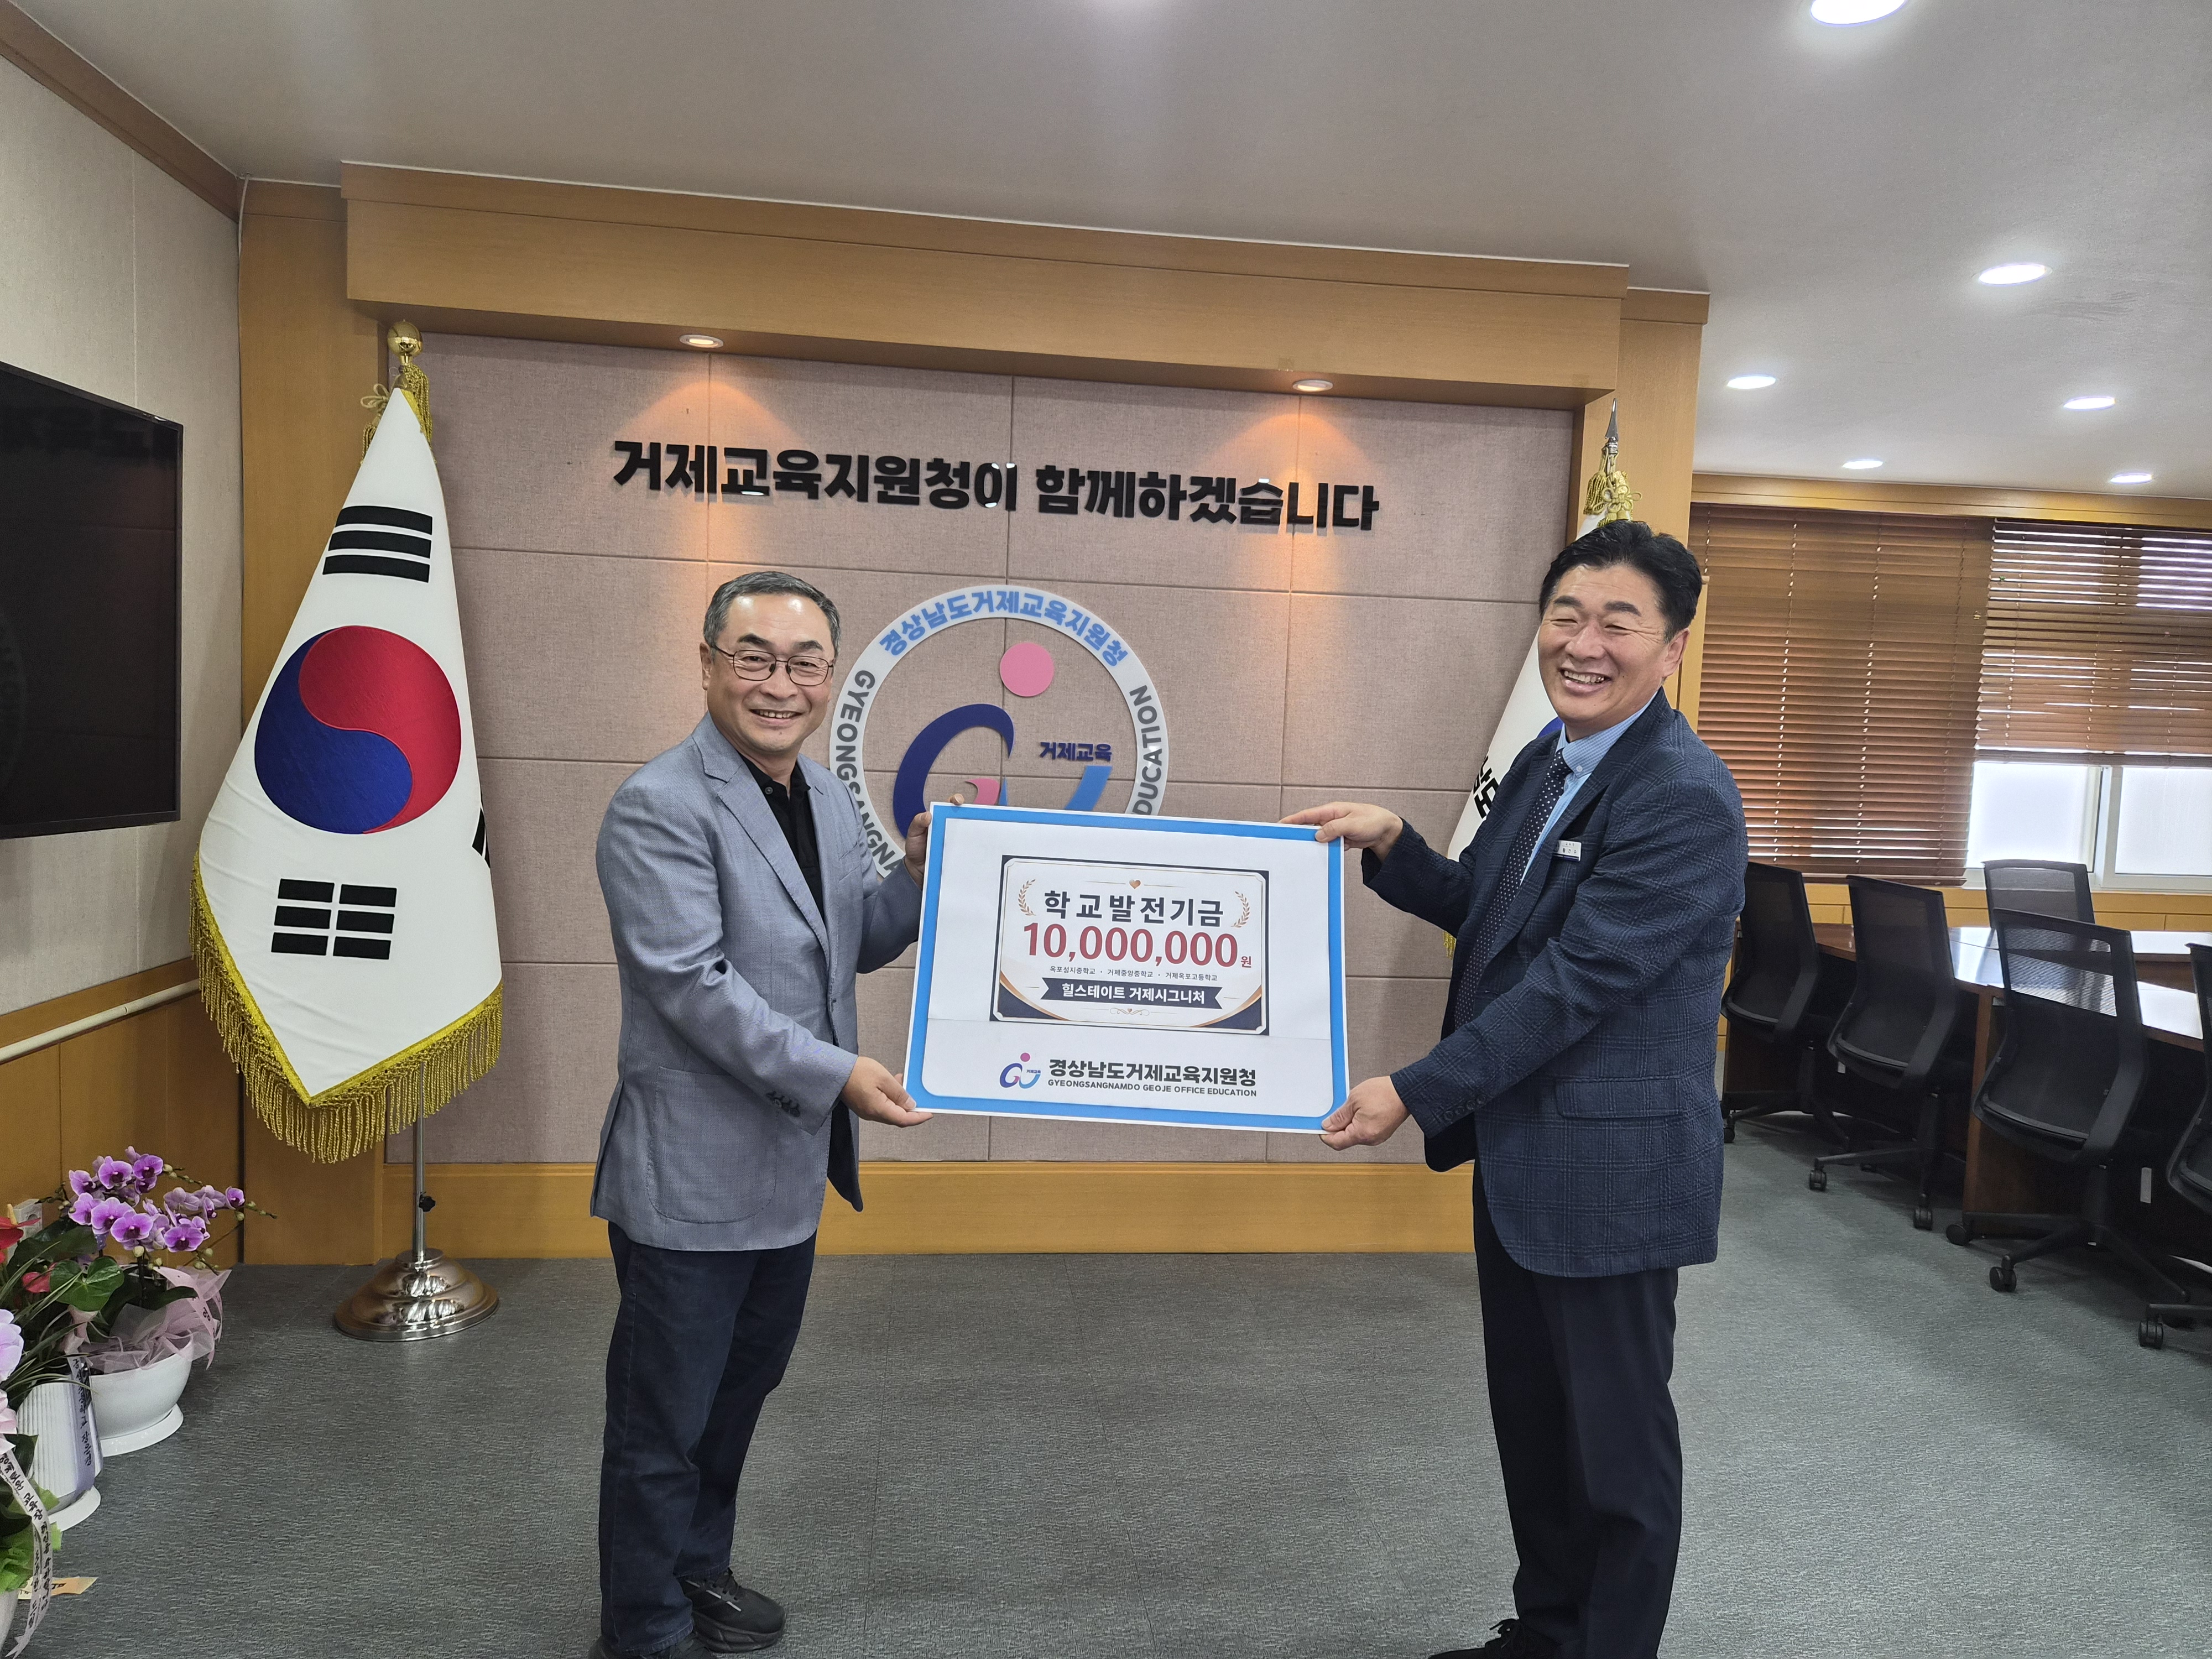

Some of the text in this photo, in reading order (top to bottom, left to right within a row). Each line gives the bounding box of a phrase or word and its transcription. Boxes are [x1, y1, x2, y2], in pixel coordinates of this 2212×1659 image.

[613, 441, 1380, 531] 거제교육지원청이 함께하겠습니다
[880, 590, 1129, 666] 경상남도거제교육지원청
[1040, 742, 1113, 762] 거제교육
[1129, 685, 1162, 815] DUCATION
[1044, 890, 1224, 927] 학교발전기금
[1050, 966, 1218, 982] 옥포성지중학교 거제중앙중학교 거제옥포고등학교
[1062, 983, 1205, 1004] 힐스테이트 거제시그니처
[1049, 1058, 1256, 1087] 경상남도거제교육지원청
[1048, 1079, 1257, 1097] GYEONGSANGNAMDO GEOJE OFFICE EDUCATION
